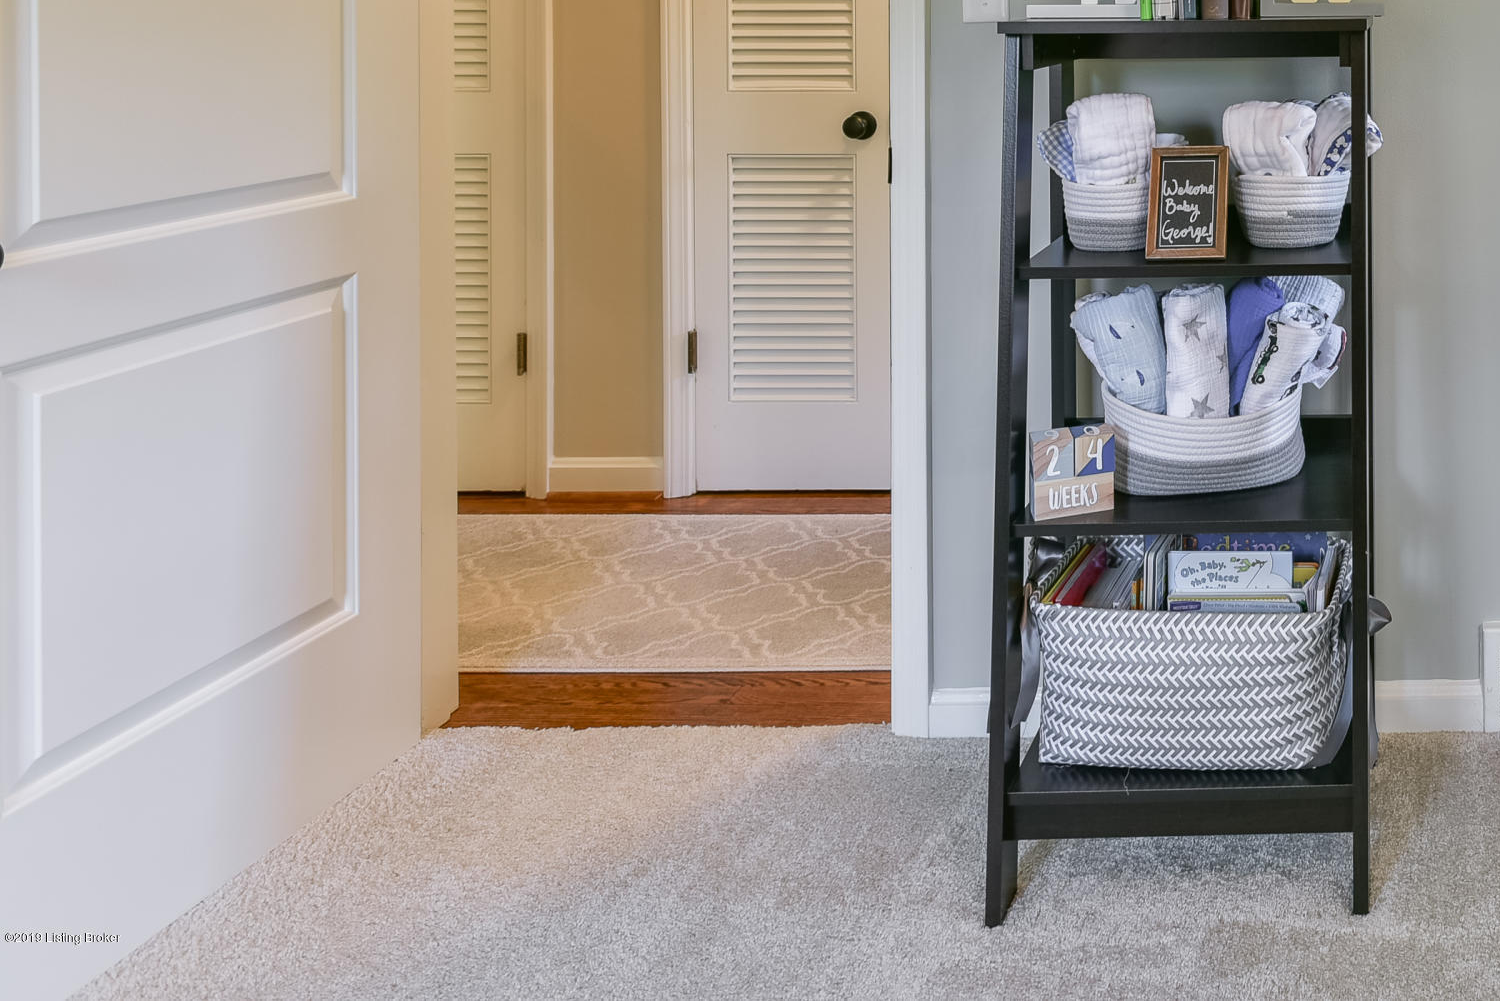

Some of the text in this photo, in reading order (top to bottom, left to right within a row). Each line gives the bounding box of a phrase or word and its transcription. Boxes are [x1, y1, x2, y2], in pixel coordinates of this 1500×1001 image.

[1163, 179, 1214, 196] Welcome
[1165, 198, 1200, 223] Baby
[1162, 219, 1213, 244] George!
[1048, 482, 1098, 510] WEEKS
[1190, 577, 1206, 587] the
[1207, 572, 1239, 584] Places
